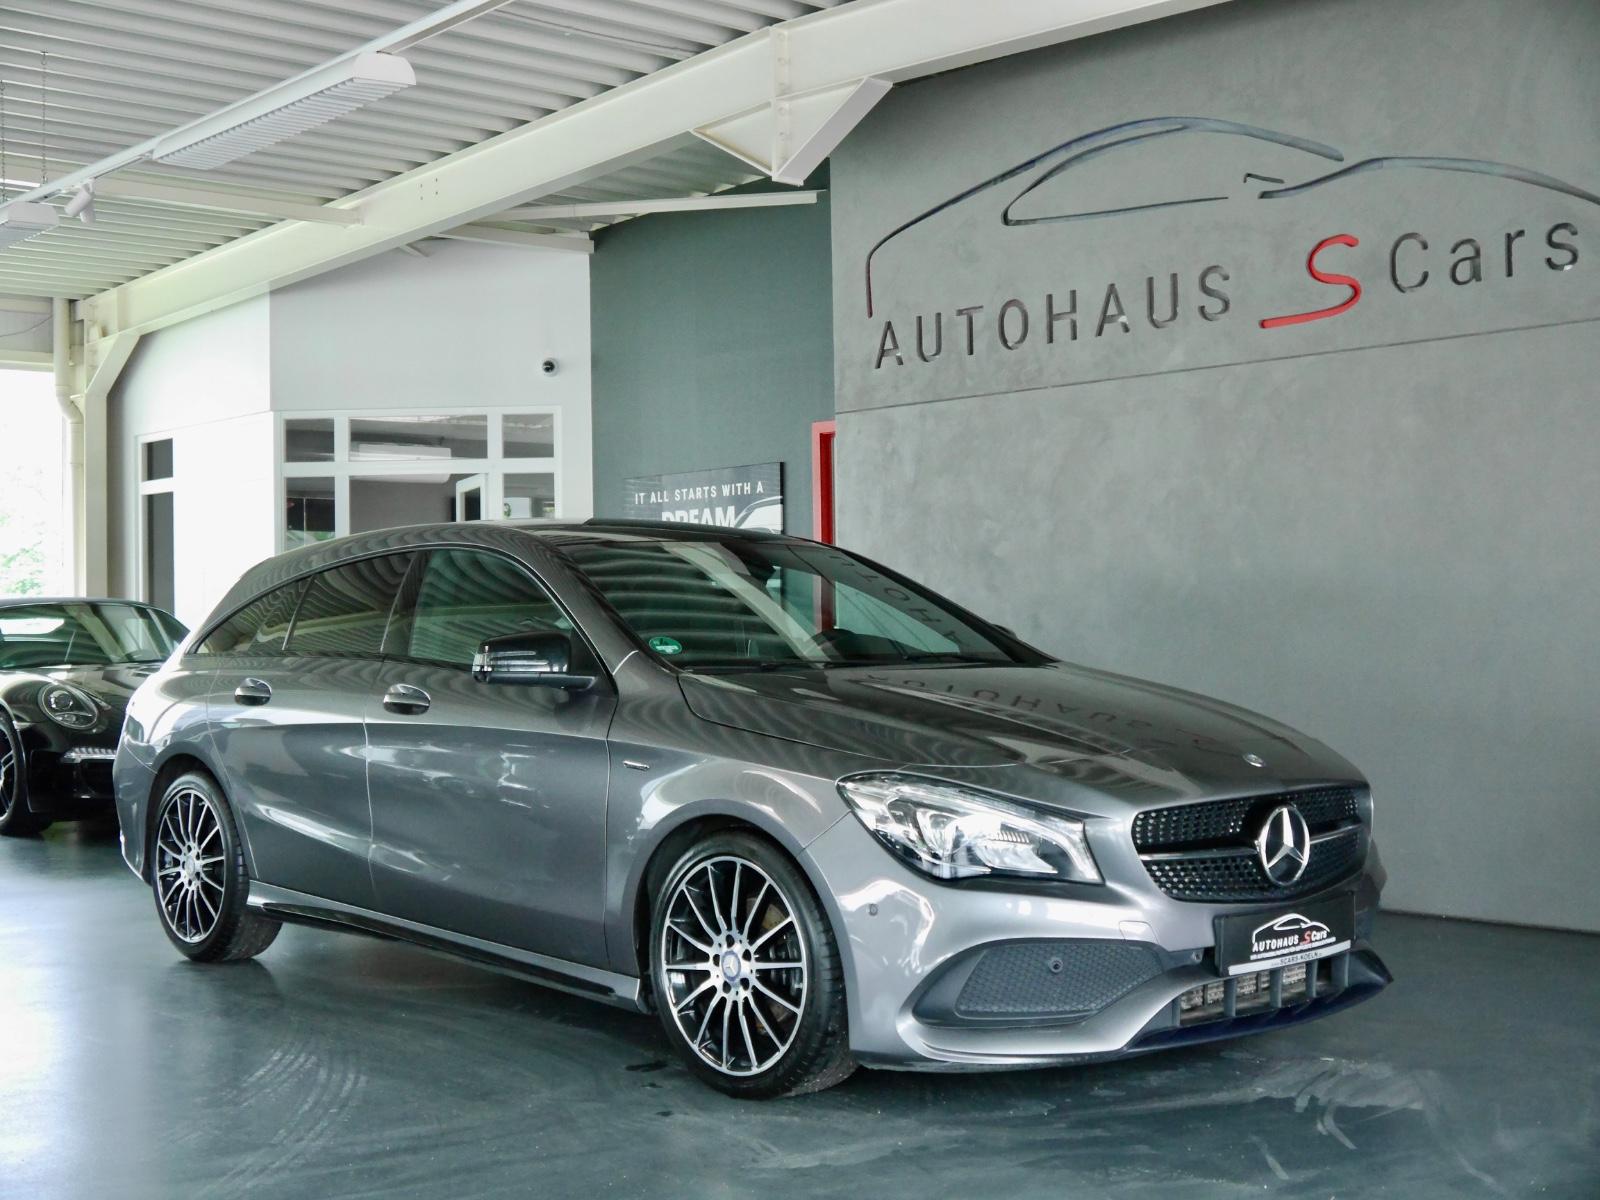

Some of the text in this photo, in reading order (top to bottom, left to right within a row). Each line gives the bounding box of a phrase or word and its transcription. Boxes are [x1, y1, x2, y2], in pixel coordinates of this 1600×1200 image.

[874, 265, 1232, 370] AUTOHAUS
[635, 481, 764, 505] IT ALL STARTS WITH A
[1252, 935, 1299, 953] AUTOHAUS
